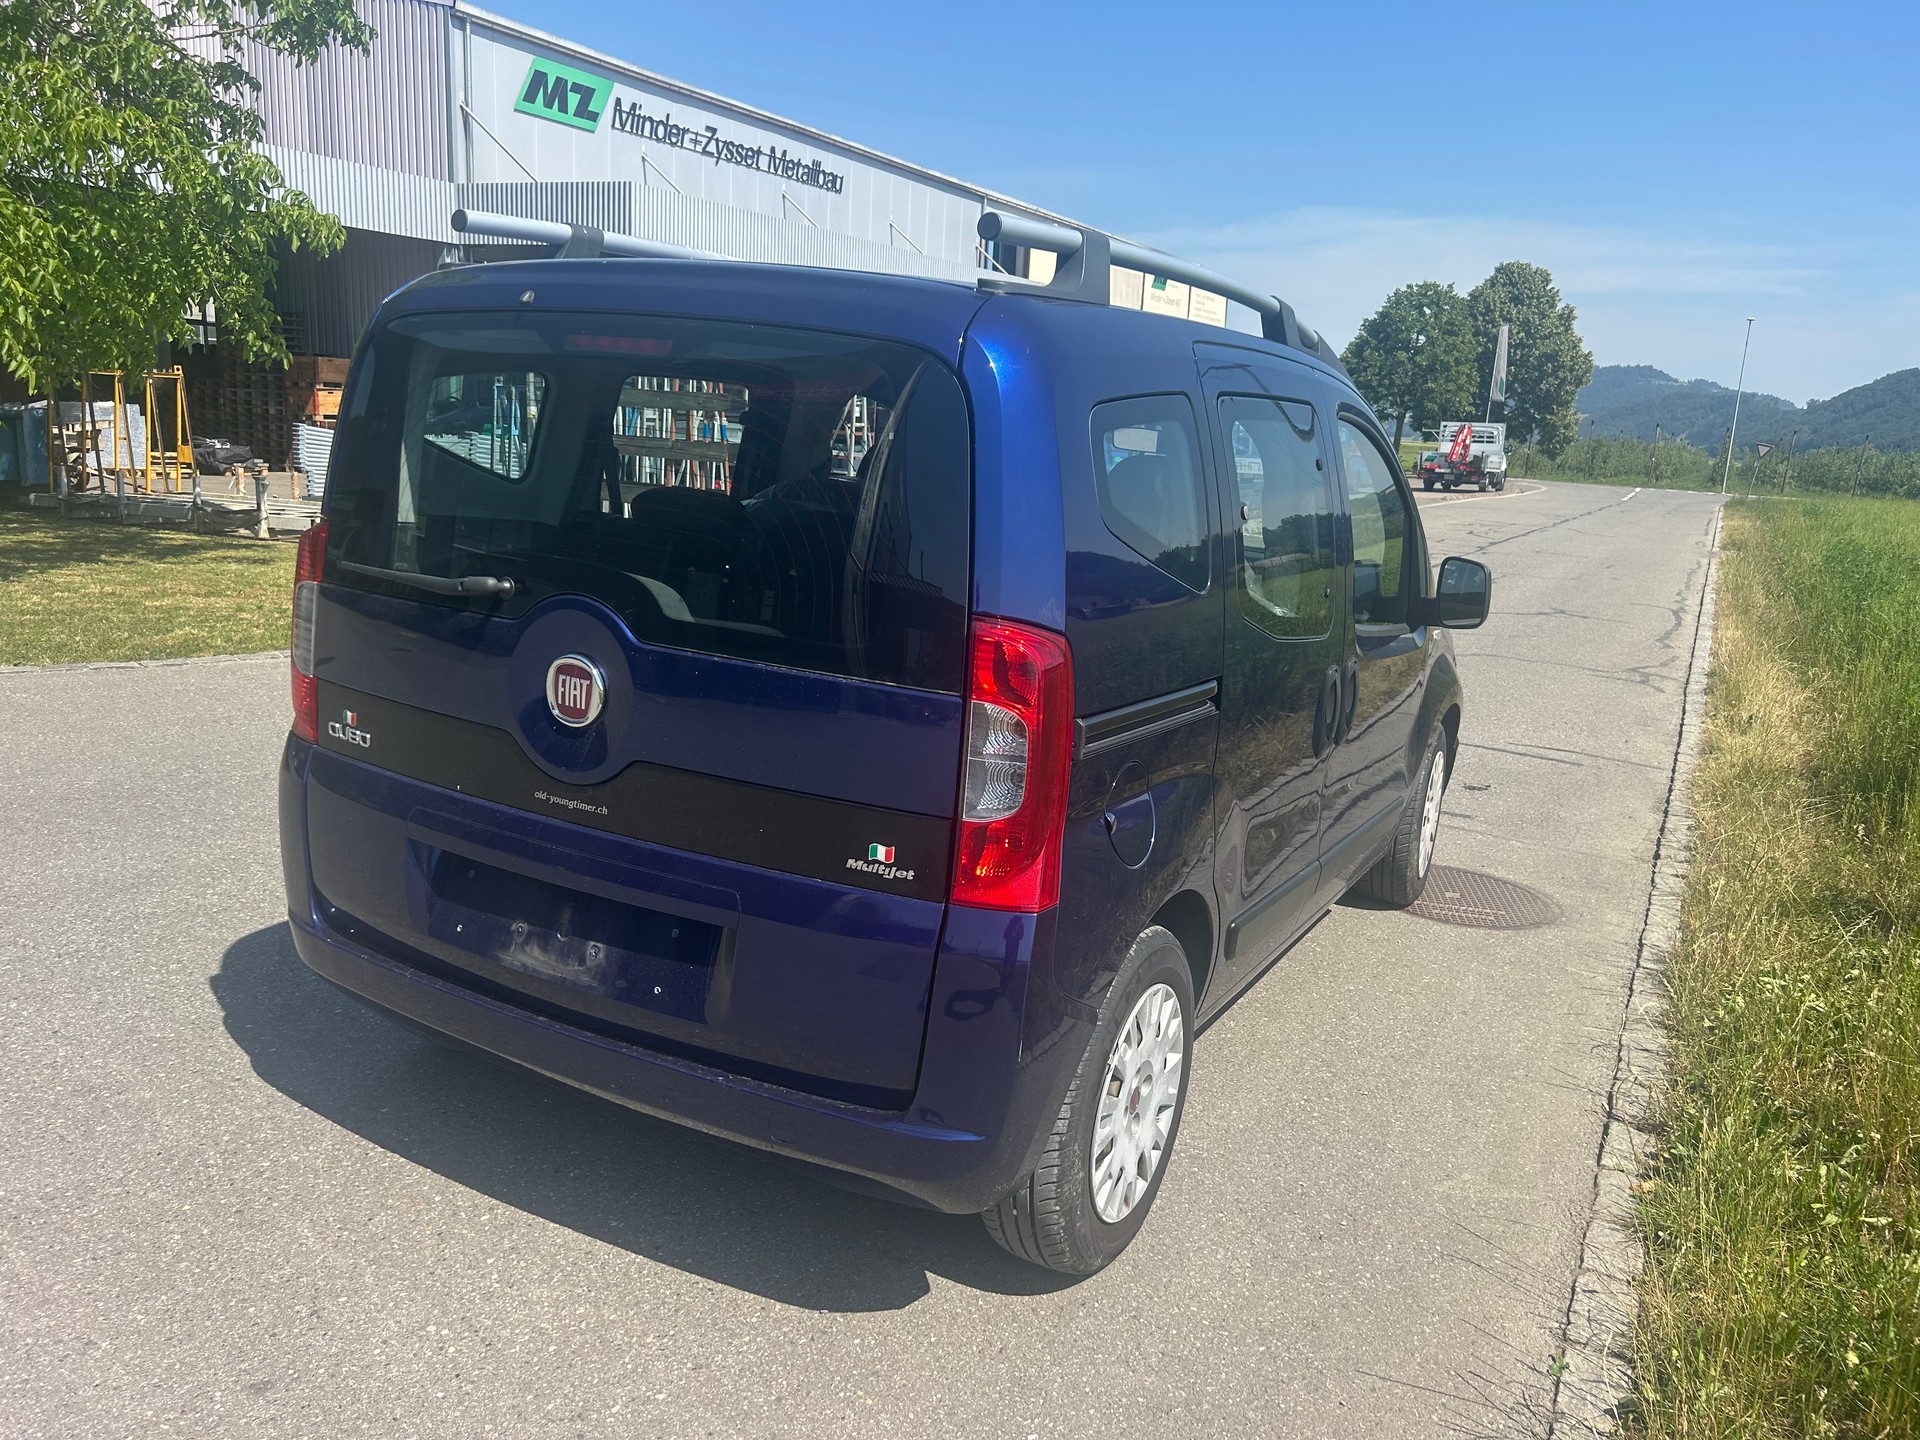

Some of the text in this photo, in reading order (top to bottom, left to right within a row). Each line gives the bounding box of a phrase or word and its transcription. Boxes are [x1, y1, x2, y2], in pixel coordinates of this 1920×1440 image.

[522, 69, 599, 122] MZ
[768, 145, 844, 194] Metallbau
[558, 674, 590, 710] FIAT
[534, 790, 608, 815] old-youngtimer.ch
